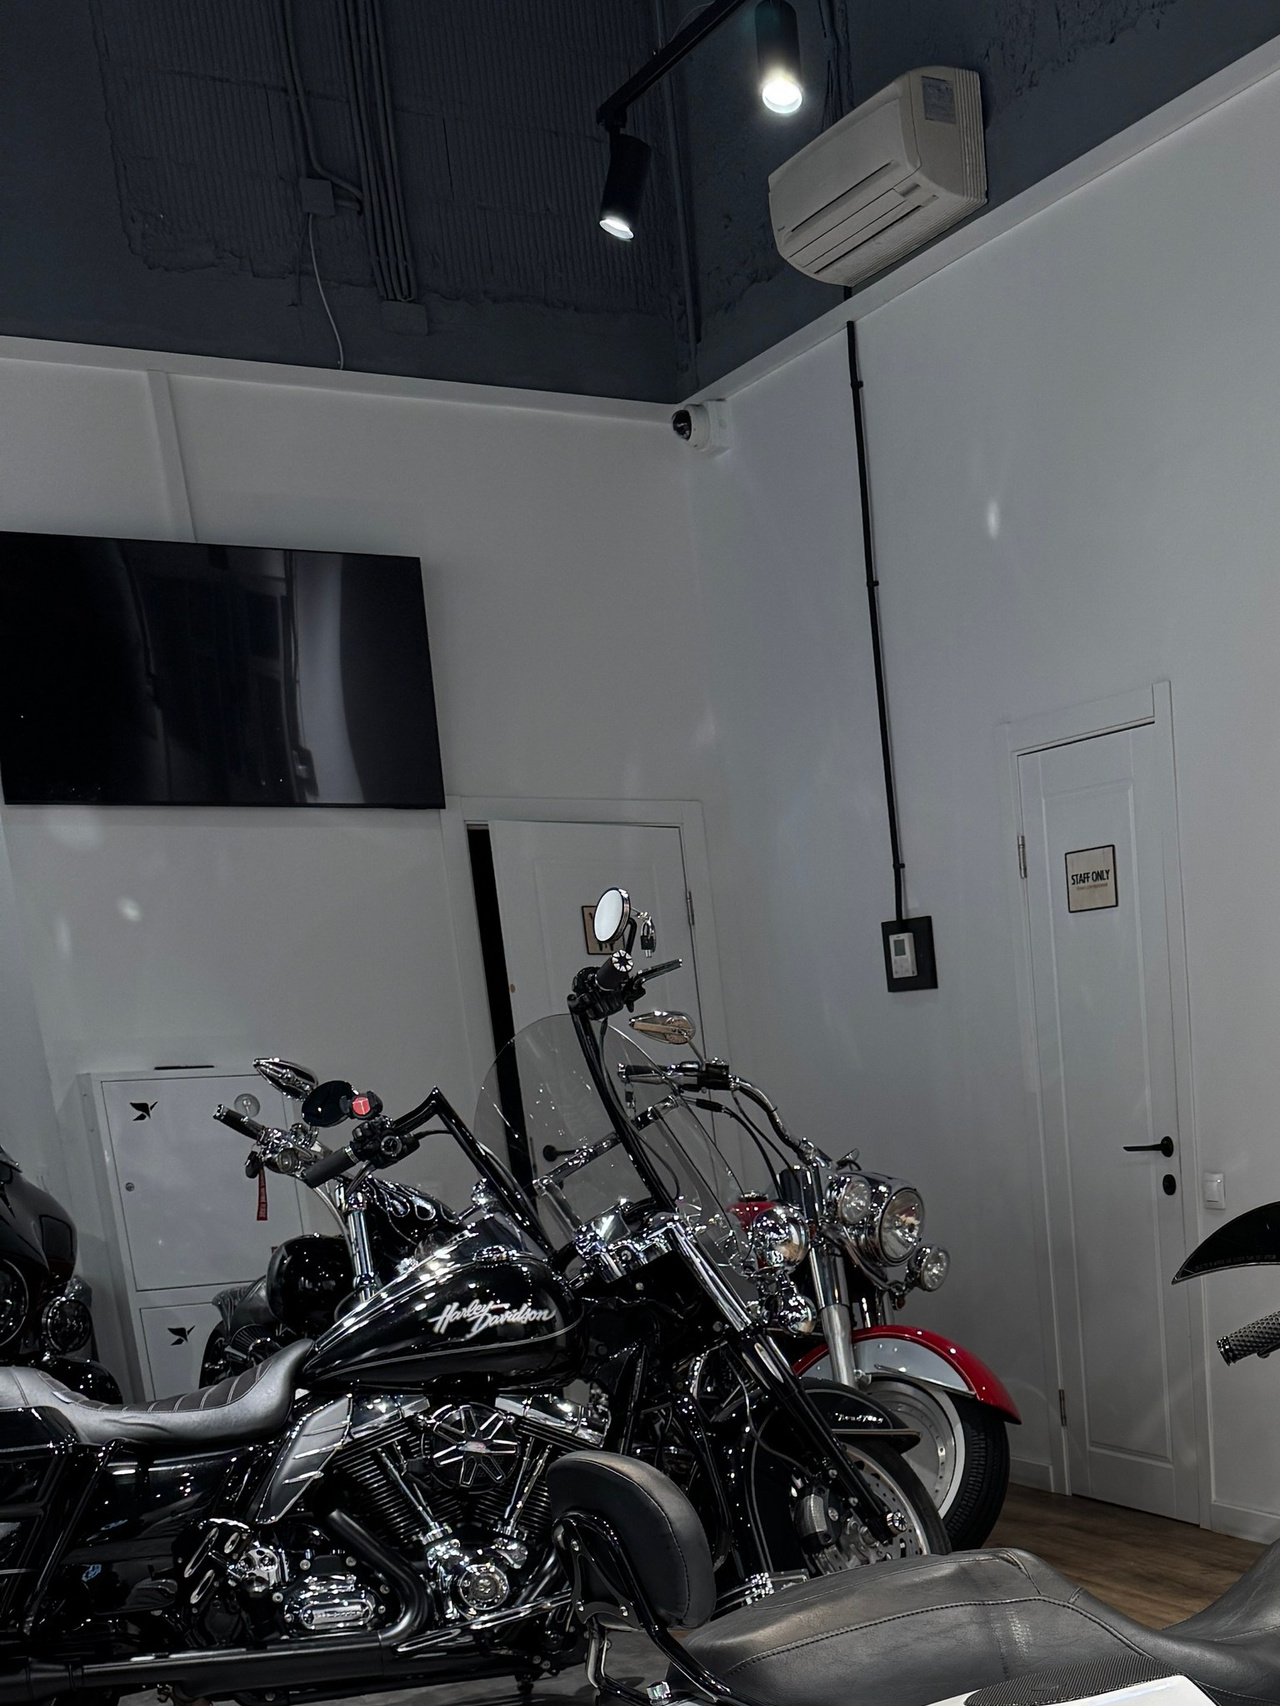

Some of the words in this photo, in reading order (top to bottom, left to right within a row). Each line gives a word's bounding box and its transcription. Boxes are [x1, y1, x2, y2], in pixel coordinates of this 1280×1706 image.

[1071, 871, 1091, 886] STAFF
[1091, 868, 1110, 883] ONLY
[427, 1299, 496, 1335] Harley
[465, 1303, 557, 1340] Davidson
